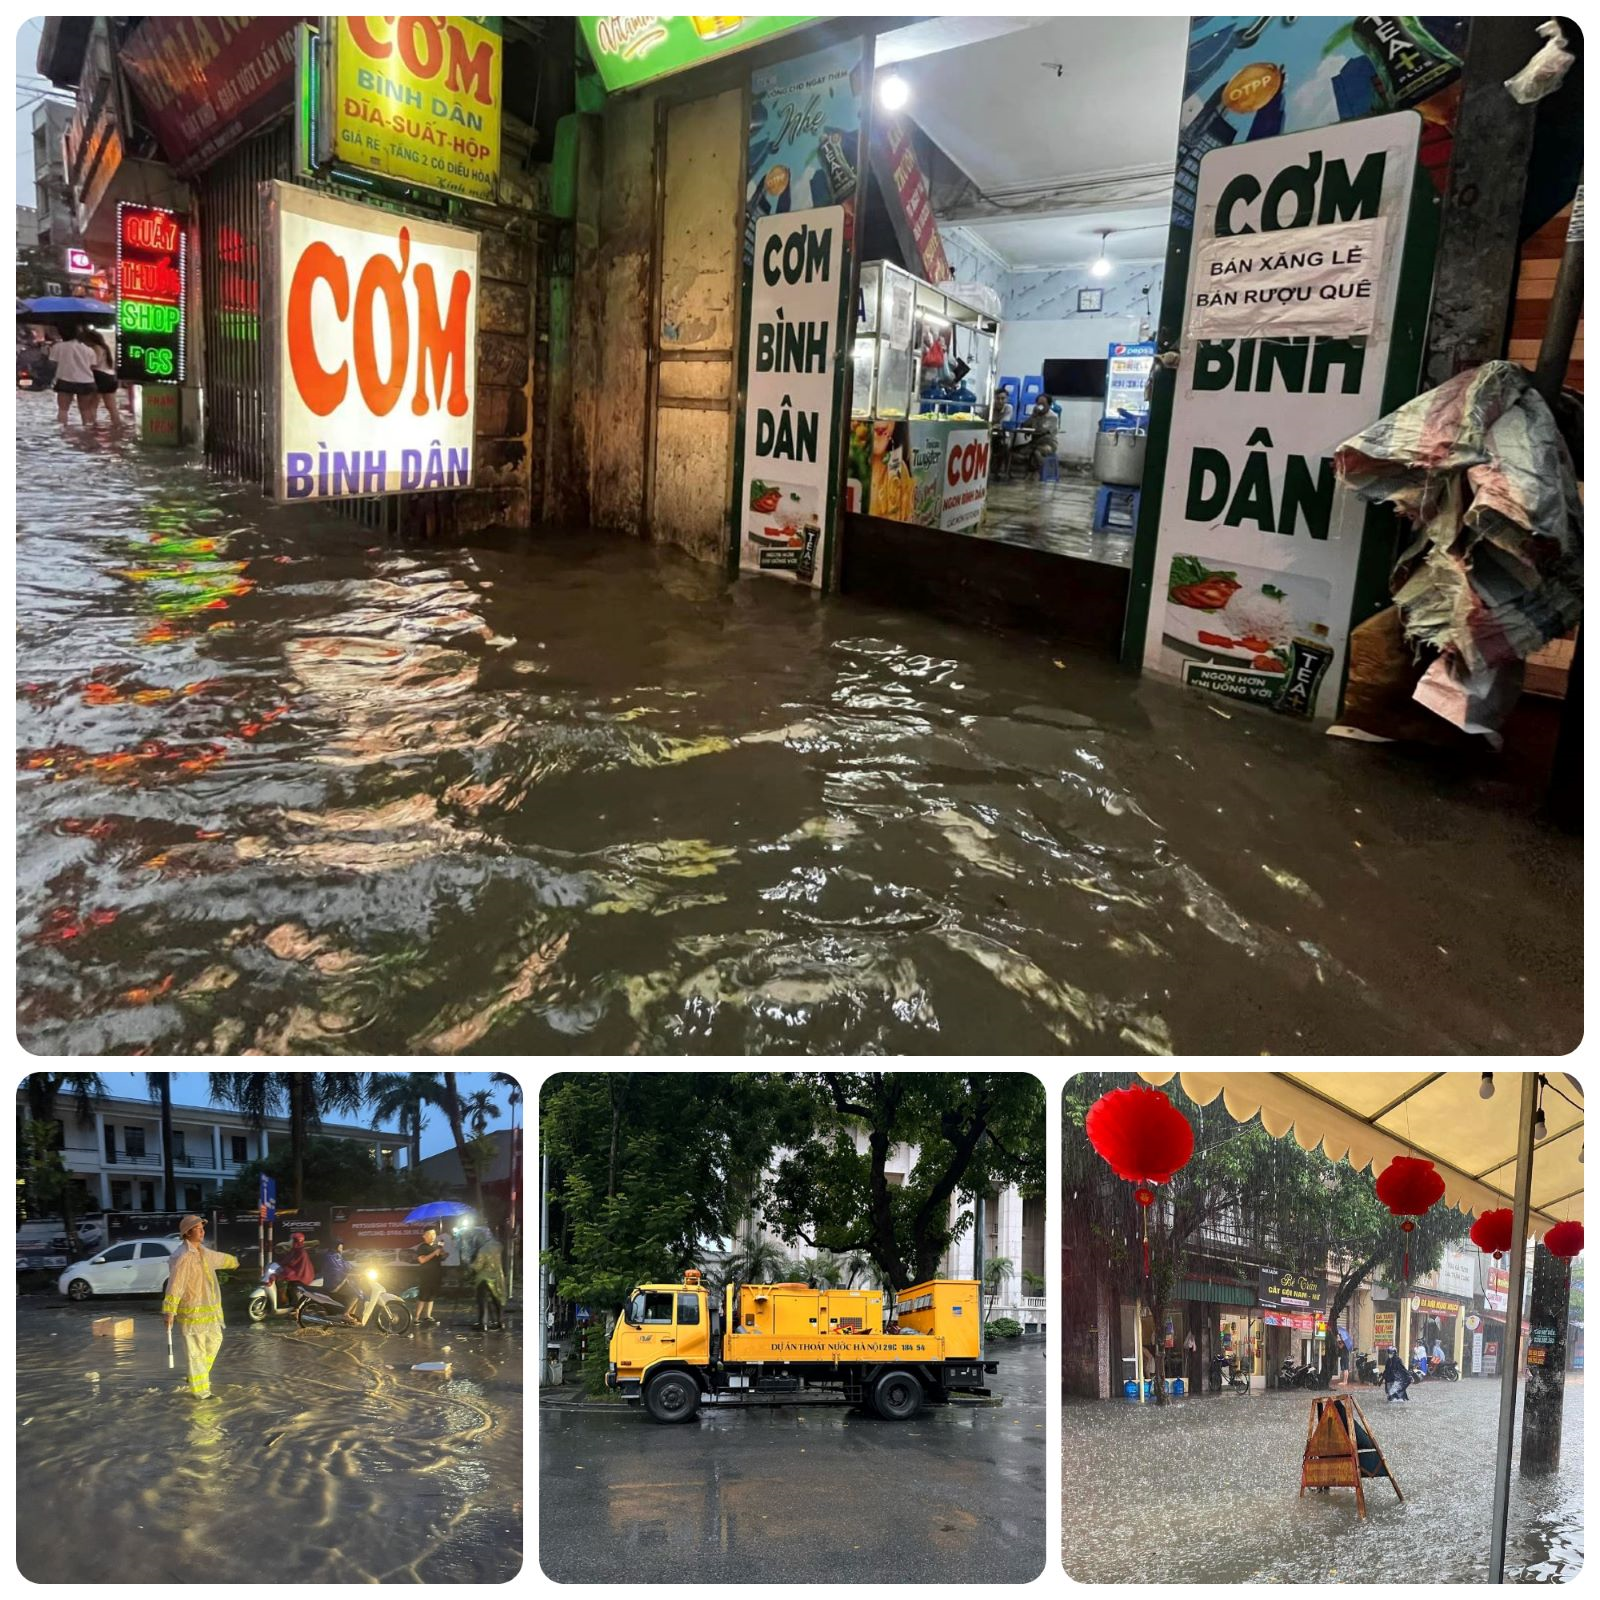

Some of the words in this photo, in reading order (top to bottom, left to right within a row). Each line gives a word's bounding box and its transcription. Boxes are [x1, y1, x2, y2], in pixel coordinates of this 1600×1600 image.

[357, 68, 422, 110] BÌNH
[432, 96, 483, 131] DÂN
[1229, 75, 1272, 101] OTPP
[342, 129, 362, 146] GIÁ
[422, 155, 428, 167] 2
[431, 154, 445, 170] CÓ
[1215, 150, 1388, 237] CƠM
[763, 224, 833, 287] CƠM
[1210, 257, 1252, 276] BÁN
[1259, 251, 1323, 271] XĂNG
[1332, 245, 1362, 265] LẺ
[123, 301, 180, 333] SHOP
[1196, 290, 1238, 307] BÁN
[1244, 286, 1311, 306] RƯỢU
[1319, 279, 1372, 300] QUÊ
[287, 226, 471, 417] CƠM
[756, 306, 829, 374] BÌNH
[756, 394, 819, 463] DÂN
[286, 441, 387, 499] BÌNH
[401, 439, 472, 490] DÂN
[948, 438, 989, 487] CƠM
[1185, 427, 1335, 541] DÂN
[1201, 671, 1236, 682] NGON
[1238, 676, 1266, 687] HƠN
[771, 1341, 784, 1352] DỰ
[785, 1341, 797, 1351] ÁN
[799, 1341, 826, 1351] THOÁT
[828, 1341, 852, 1351] NƯỚC
[853, 1341, 866, 1351] HÀ
[867, 1341, 882, 1352] NỘI
